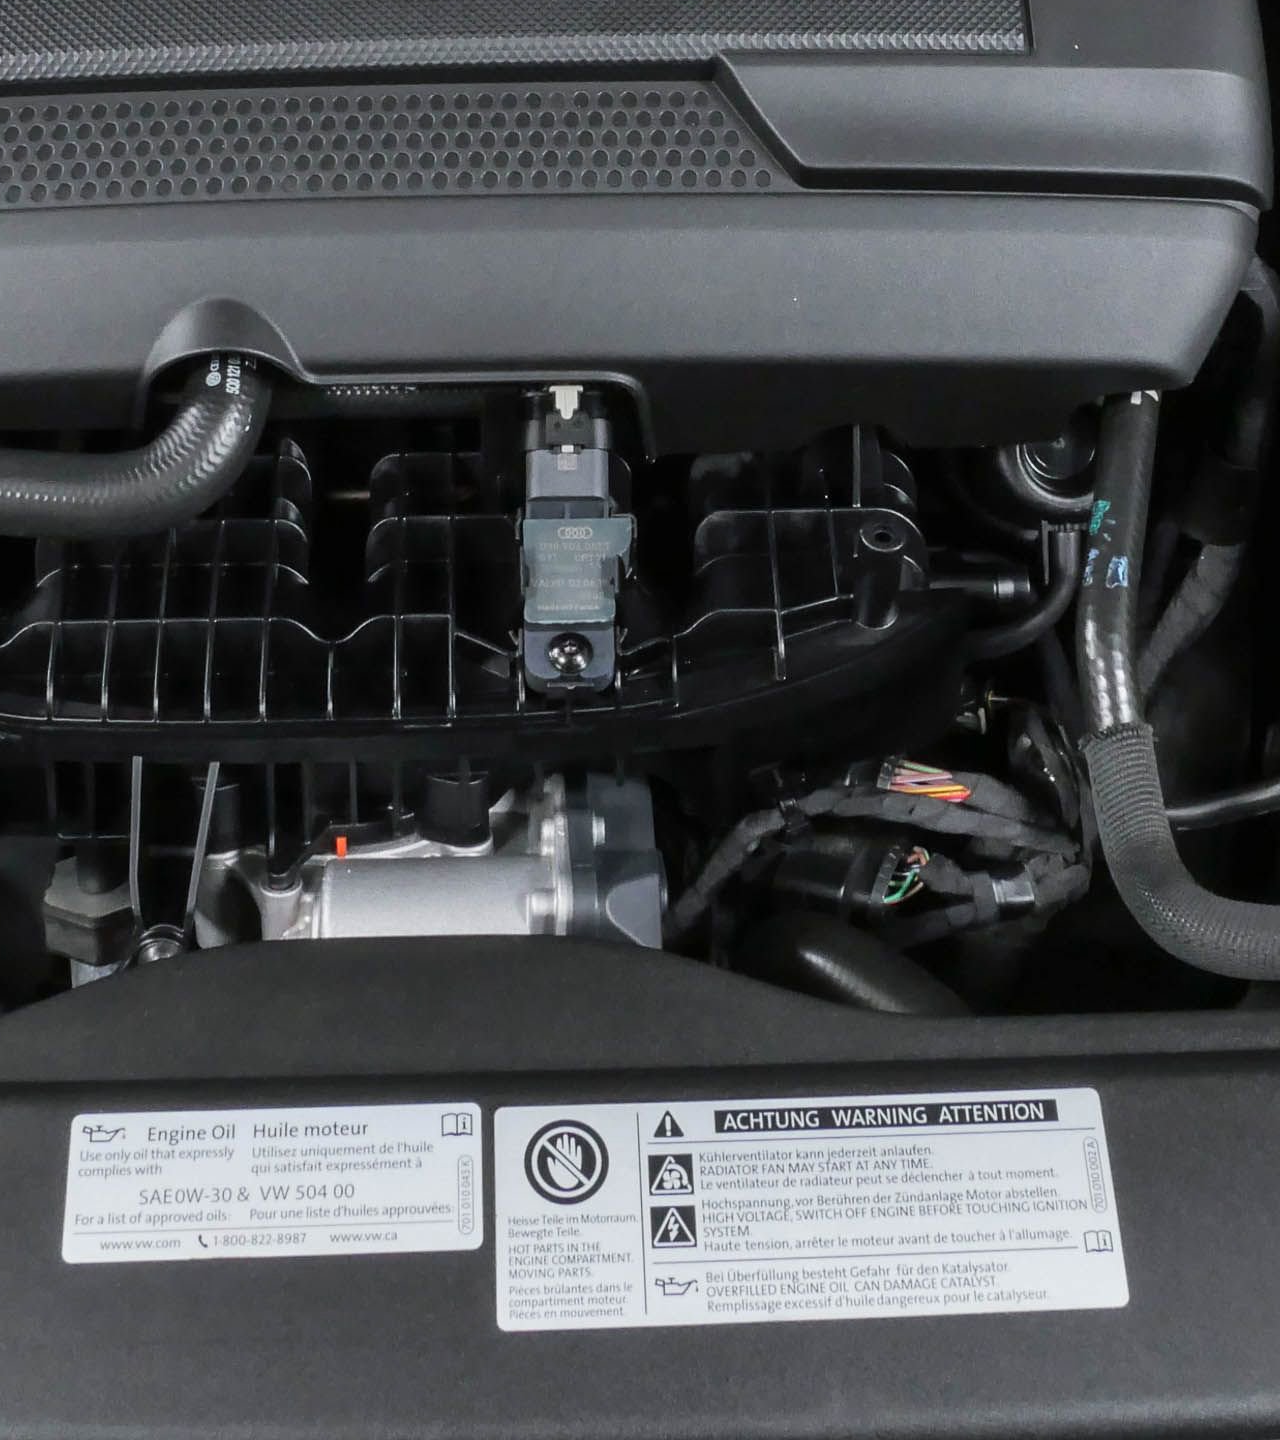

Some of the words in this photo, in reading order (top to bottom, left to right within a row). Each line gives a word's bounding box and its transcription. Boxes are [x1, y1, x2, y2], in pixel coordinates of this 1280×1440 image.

[723, 1109, 820, 1130] ACHTUNG
[830, 1106, 927, 1126] WARNING
[938, 1102, 1044, 1123] ATTENTION
[147, 1125, 207, 1146] Engine
[211, 1123, 236, 1140] Oil
[252, 1121, 299, 1138] Huile
[303, 1120, 368, 1137] moteur
[79, 1149, 102, 1162] Use
[104, 1148, 131, 1164] only
[132, 1147, 148, 1160] oil
[150, 1147, 176, 1163] that
[177, 1145, 235, 1162] expressly
[251, 1145, 297, 1159] Utilisez
[299, 1143, 376, 1159] uniquement
[378, 1141, 394, 1154] de
[396, 1140, 434, 1153] l'huile
[698, 1149, 792, 1163] Kühlerventilator
[795, 1148, 824, 1160] kann
[826, 1146, 878, 1162] jederzeit
[77, 1164, 132, 1180] complies
[134, 1162, 162, 1176] with
[250, 1163, 271, 1177] qui
[273, 1159, 322, 1173] satisfait
[325, 1157, 412, 1174] expressément
[414, 1156, 422, 1168] à
[699, 1163, 759, 1177] RADIATOR
[760, 1162, 785, 1174] FAN
[787, 1161, 815, 1174] MAY
[817, 1159, 852, 1173] START
[855, 1159, 869, 1171] AT
[872, 1159, 897, 1170] ANY
[236, 1185, 250, 1202] &
[259, 1184, 290, 1201] VW
[295, 1184, 327, 1200] 504
[332, 1183, 355, 1200] 00
[74, 1213, 95, 1226] For
[96, 1215, 105, 1225] a
[107, 1212, 126, 1225] list
[128, 1210, 142, 1225] of
[144, 1208, 204, 1227] approved
[249, 1208, 278, 1220] Pour
[279, 1209, 303, 1220] une
[305, 1206, 331, 1219] liste
[332, 1202, 379, 1218] d'huiles
[701, 1211, 734, 1224] HIGH
[794, 1207, 843, 1221] SWITCH
[844, 1206, 867, 1219] OFF
[869, 1204, 915, 1218] ENGINE
[918, 1202, 962, 1217] BEFORE
[964, 1200, 1030, 1215] TOUCHING
[1032, 1198, 1088, 1212] IGNITION
[99, 1238, 181, 1251] www.vw.com
[213, 1231, 307, 1247] 1-800-822-8987
[328, 1230, 398, 1243] www.vw.ca
[705, 1282, 777, 1298] OVERFILLED
[779, 1280, 826, 1295] ENGINE
[828, 1280, 849, 1293] OIL
[853, 1279, 880, 1292] CAN
[882, 1276, 936, 1292] DAMAGE
